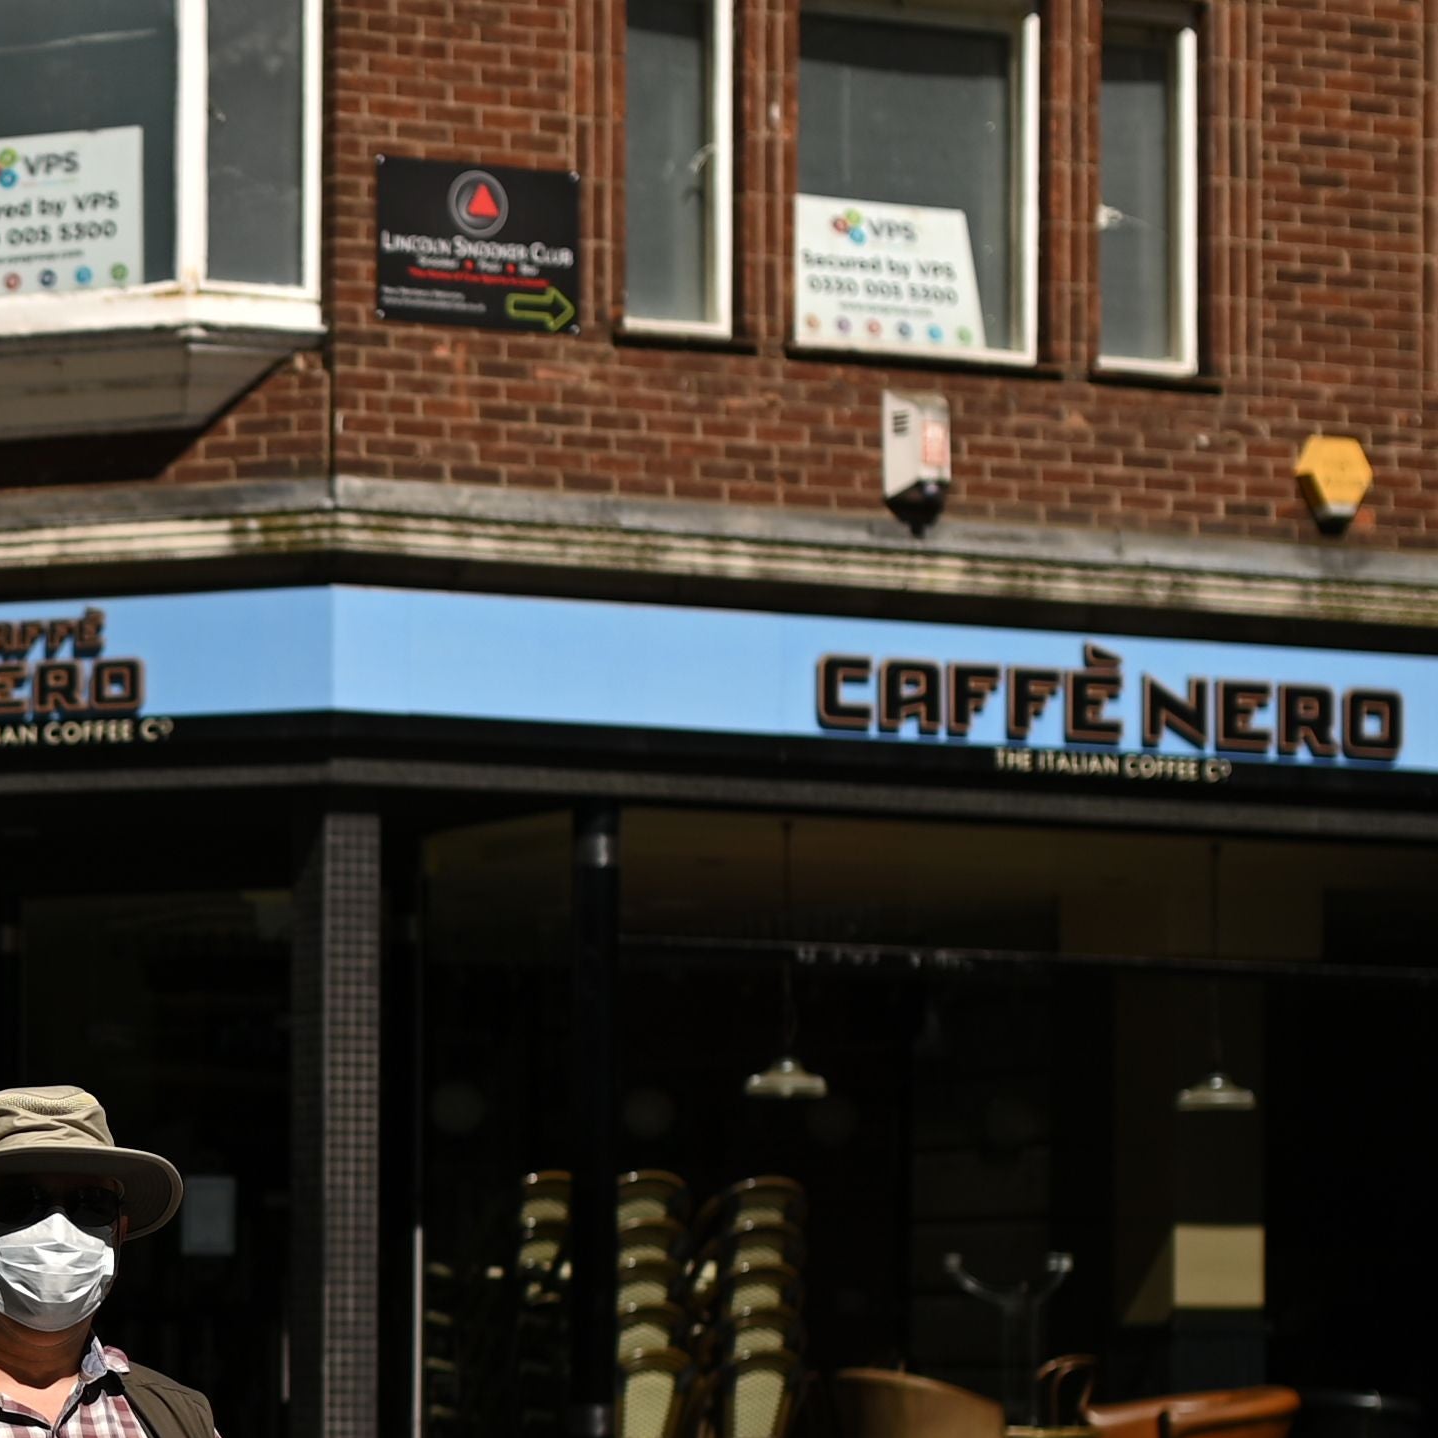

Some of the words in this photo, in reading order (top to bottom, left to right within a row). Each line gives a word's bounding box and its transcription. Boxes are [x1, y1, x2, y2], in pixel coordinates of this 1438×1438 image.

[24, 151, 79, 177] VPS
[37, 197, 67, 218] by
[74, 190, 119, 212] VPS
[868, 218, 918, 244] VPS
[529, 242, 575, 267] CLUB
[802, 250, 882, 274] Secured
[887, 257, 911, 280] by
[917, 261, 957, 282] VPS
[815, 641, 1123, 745] CAFFÈ
[1140, 673, 1405, 762] NERO
[43, 718, 134, 745] COFFEE
[995, 749, 1033, 773] THE
[1039, 751, 1120, 776] ITALIAN
[1125, 754, 1199, 782] COFFEE
